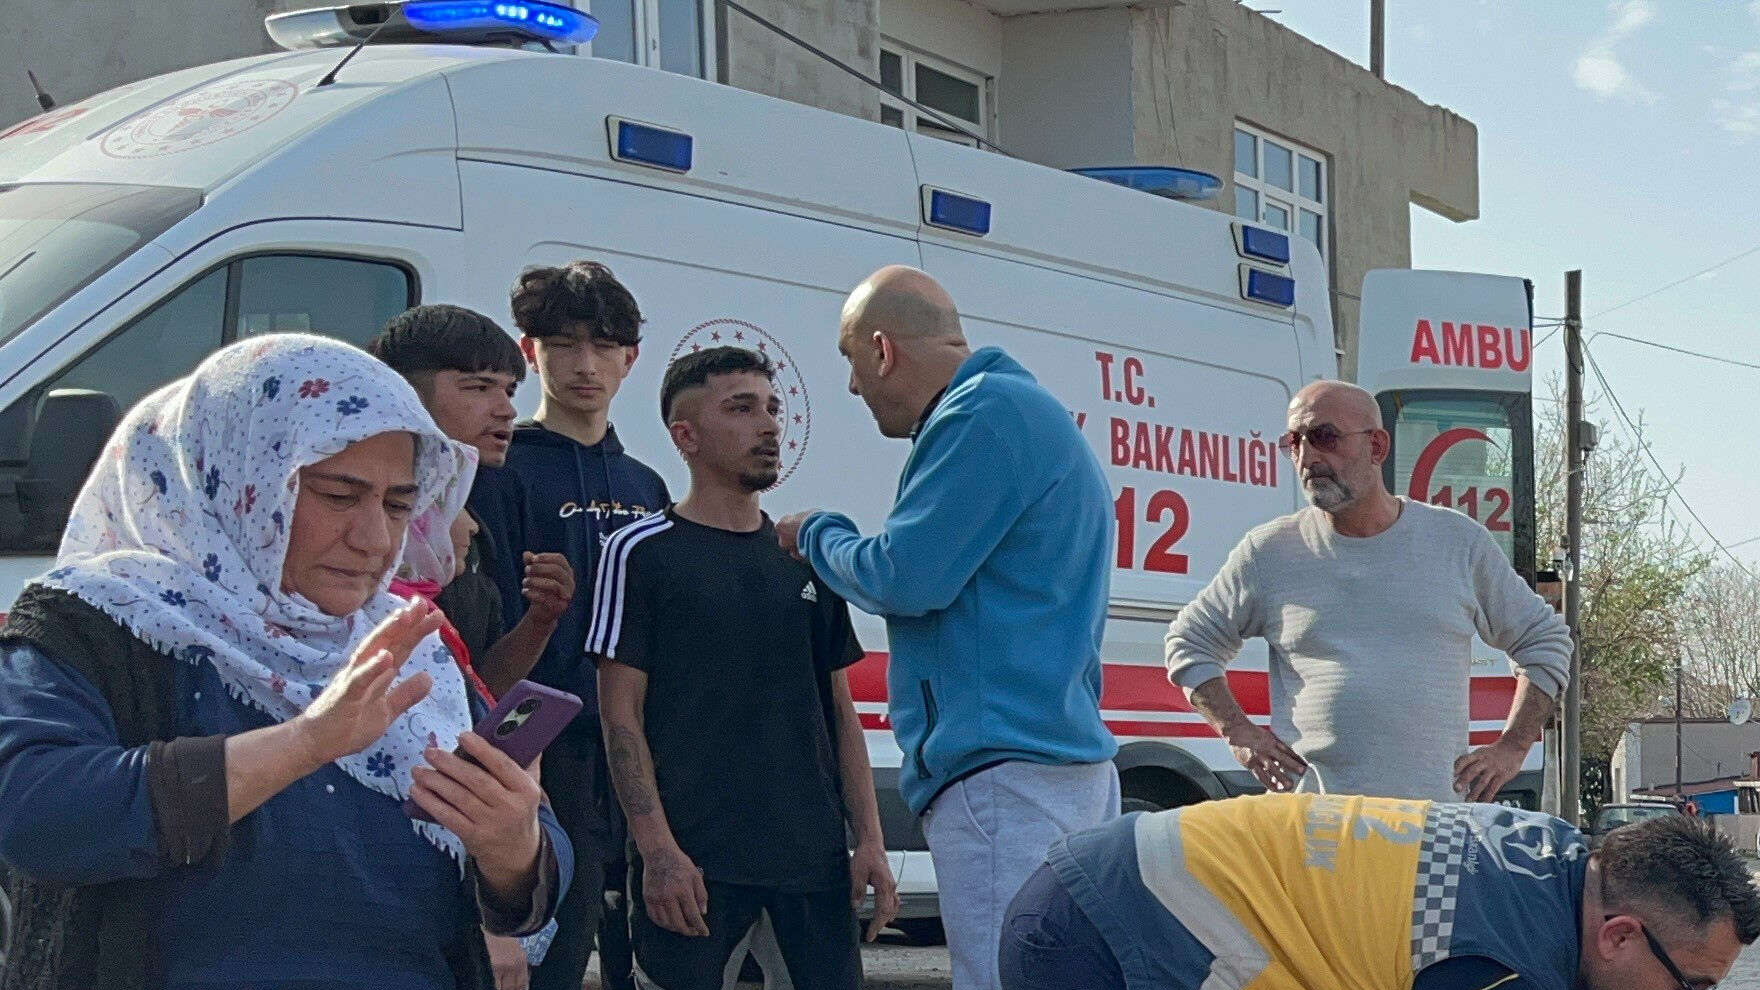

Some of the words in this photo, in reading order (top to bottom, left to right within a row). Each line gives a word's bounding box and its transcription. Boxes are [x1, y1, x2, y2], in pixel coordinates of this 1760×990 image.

[1411, 319, 1530, 372] AMBU
[1095, 351, 1155, 408] T.C.
[1110, 416, 1277, 487] BAKANLIĞI
[1114, 486, 1190, 574] 12
